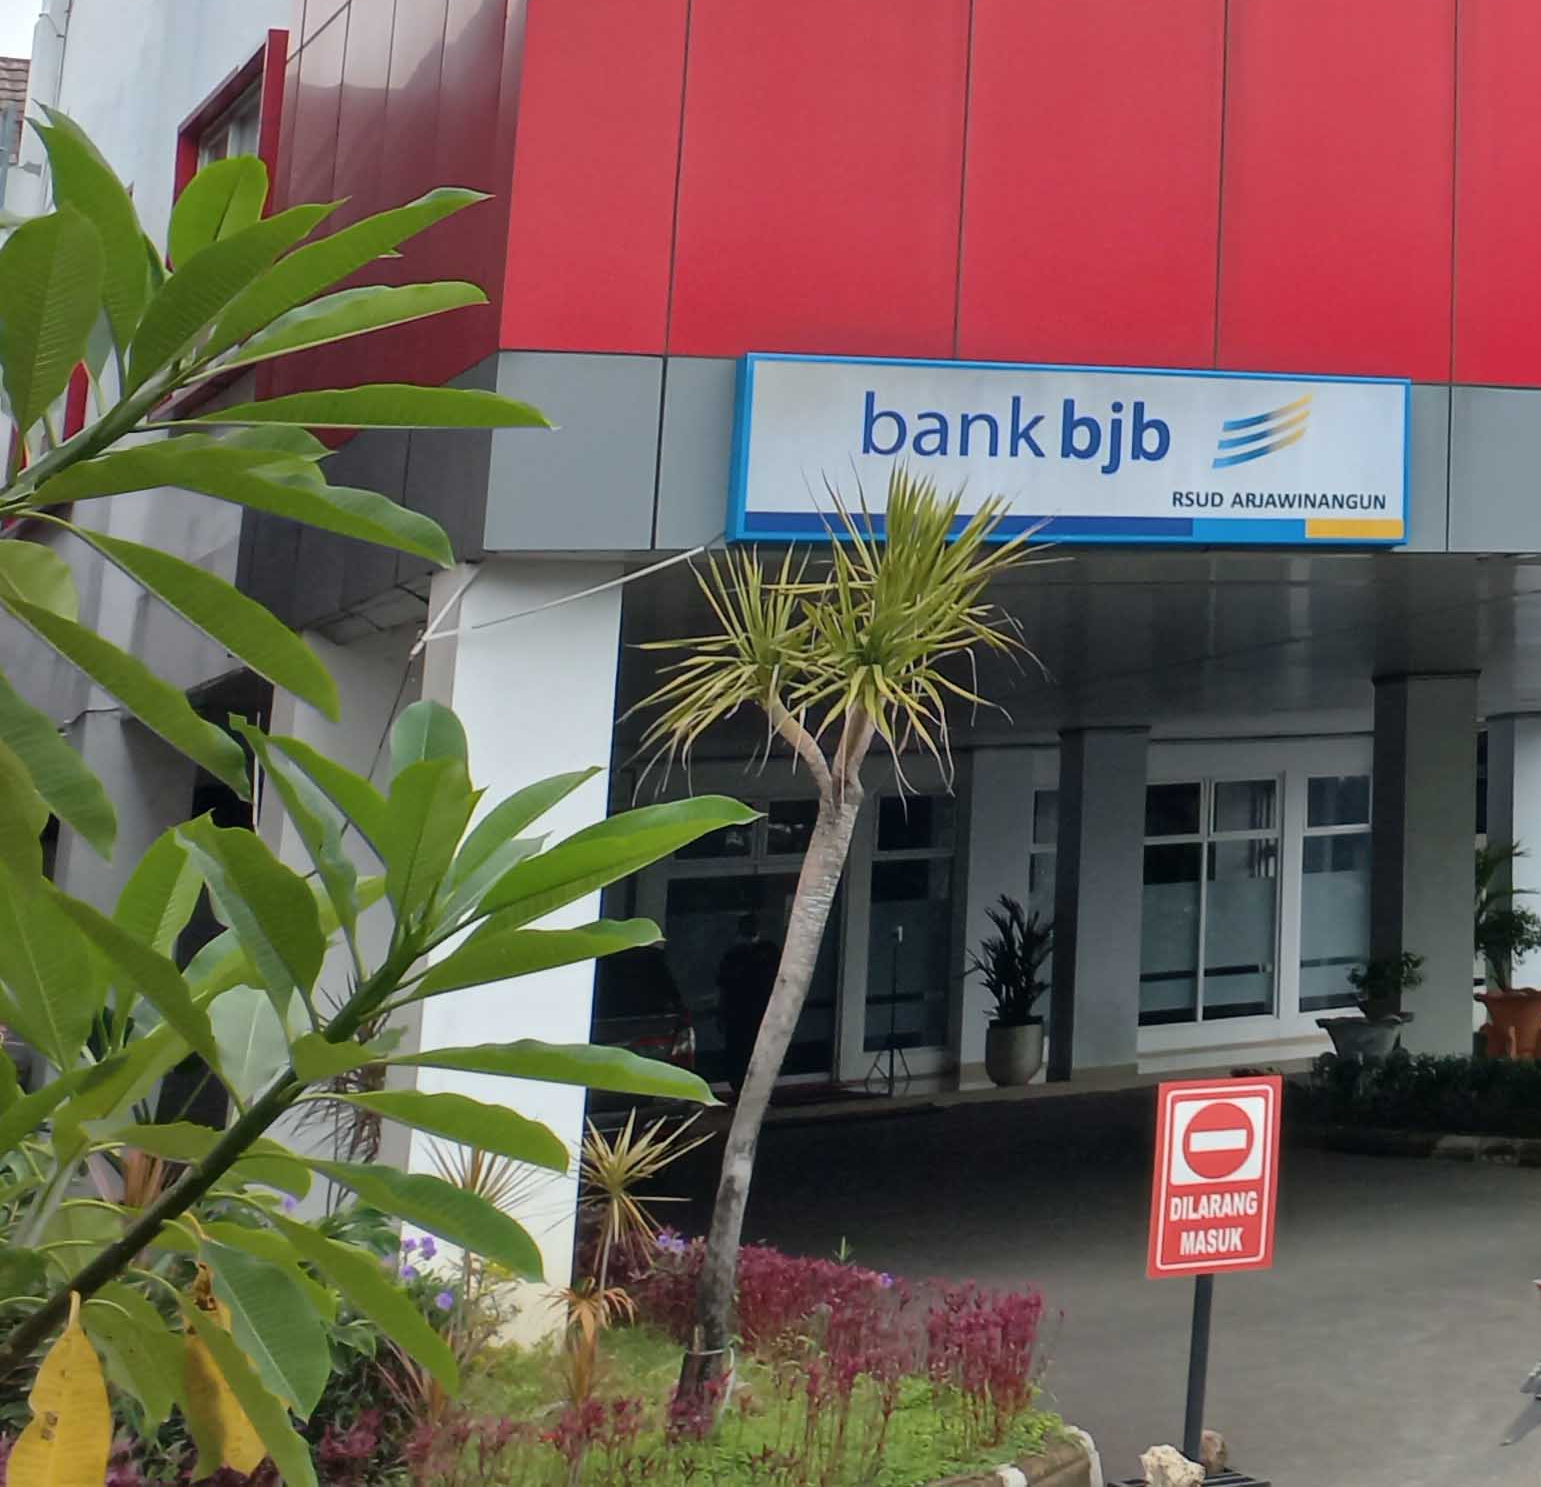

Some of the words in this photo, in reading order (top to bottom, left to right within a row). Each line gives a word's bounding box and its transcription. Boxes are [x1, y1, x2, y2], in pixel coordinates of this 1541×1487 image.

[862, 391, 1046, 459] bank
[1060, 397, 1171, 474] bjb
[1171, 491, 1224, 509] RSUD
[1231, 492, 1387, 510] ARJAWINANGUN
[1169, 1191, 1258, 1222] DILARANG
[1180, 1227, 1244, 1256] MASUK
